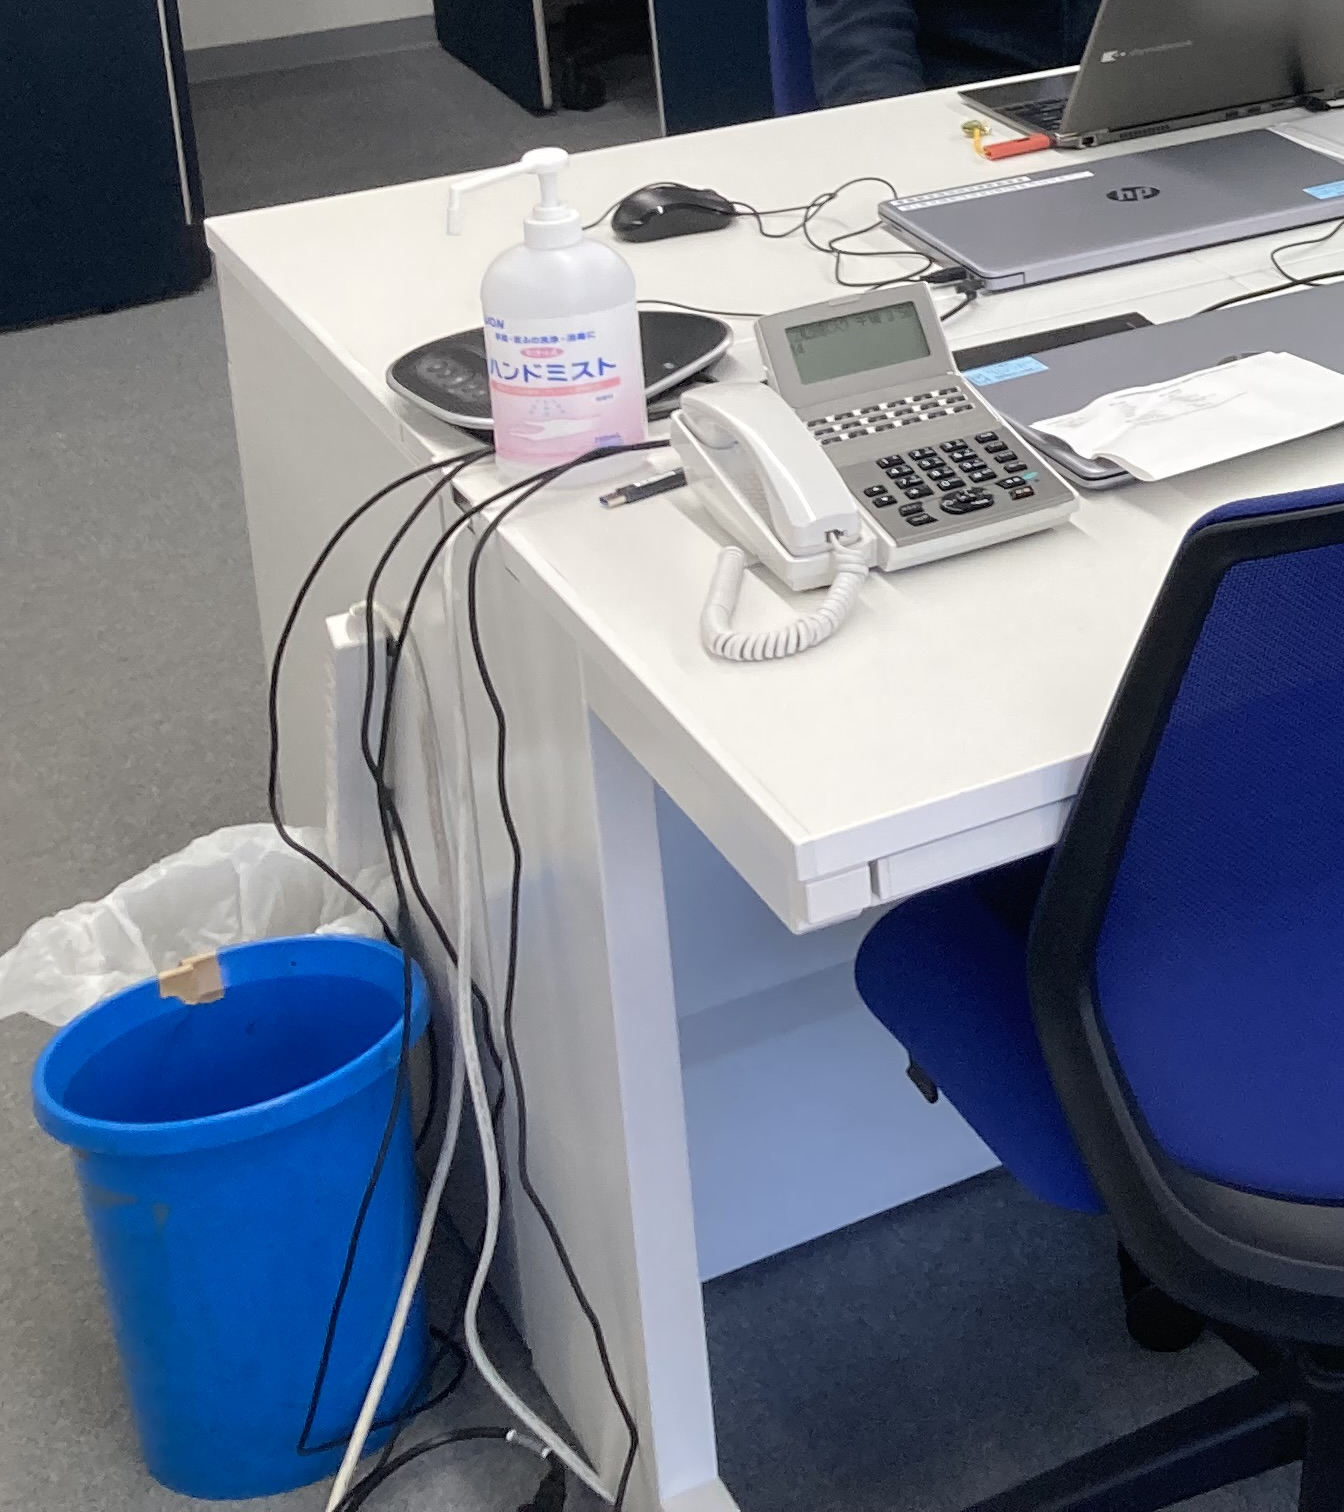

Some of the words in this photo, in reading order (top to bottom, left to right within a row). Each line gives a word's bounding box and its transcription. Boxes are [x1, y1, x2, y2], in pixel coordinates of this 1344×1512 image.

[1112, 186, 1156, 202] hp
[490, 357, 616, 383] ハンドミスト
